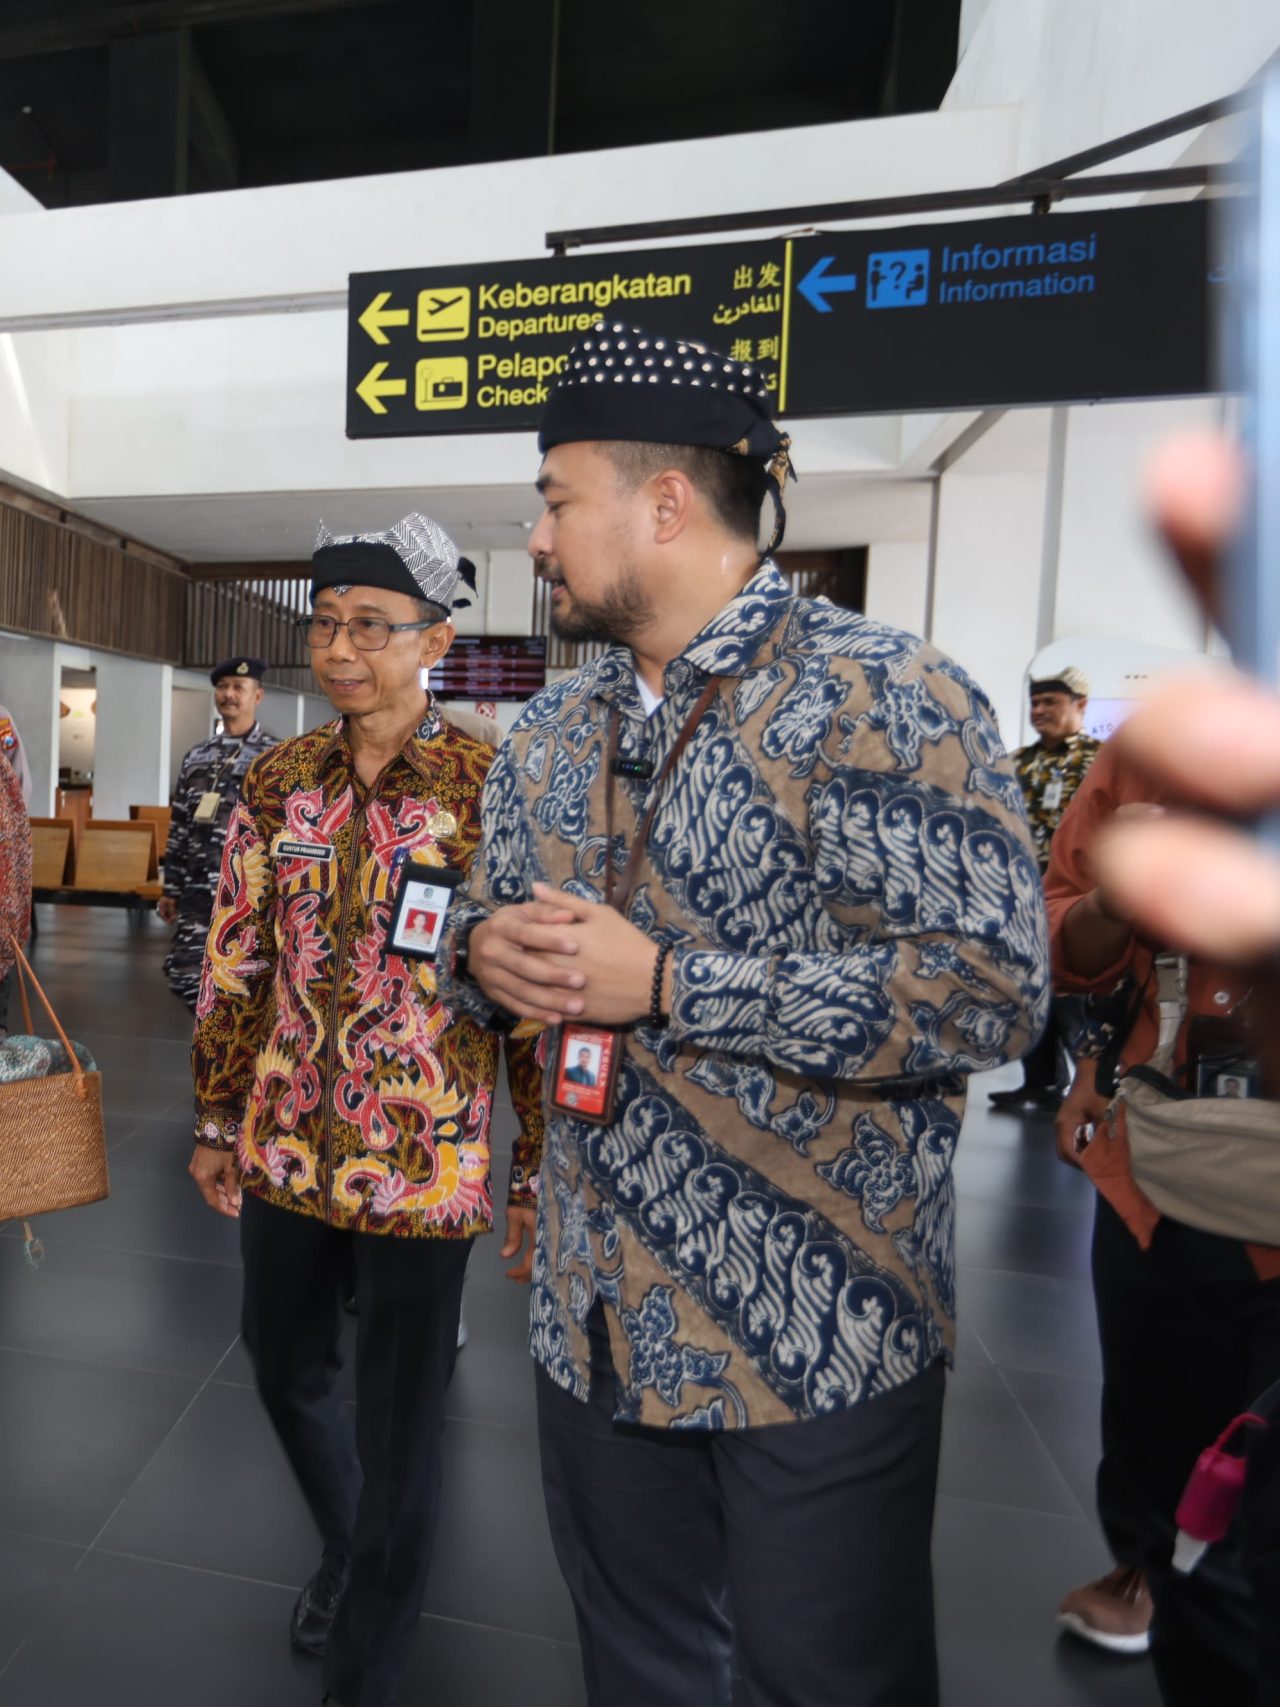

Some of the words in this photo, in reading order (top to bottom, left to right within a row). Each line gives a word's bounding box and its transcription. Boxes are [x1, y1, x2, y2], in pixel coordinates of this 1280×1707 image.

[941, 233, 1097, 273] Informasi
[477, 273, 693, 307] Keberangkatan
[733, 262, 782, 290] 出发
[938, 272, 1096, 304] Information
